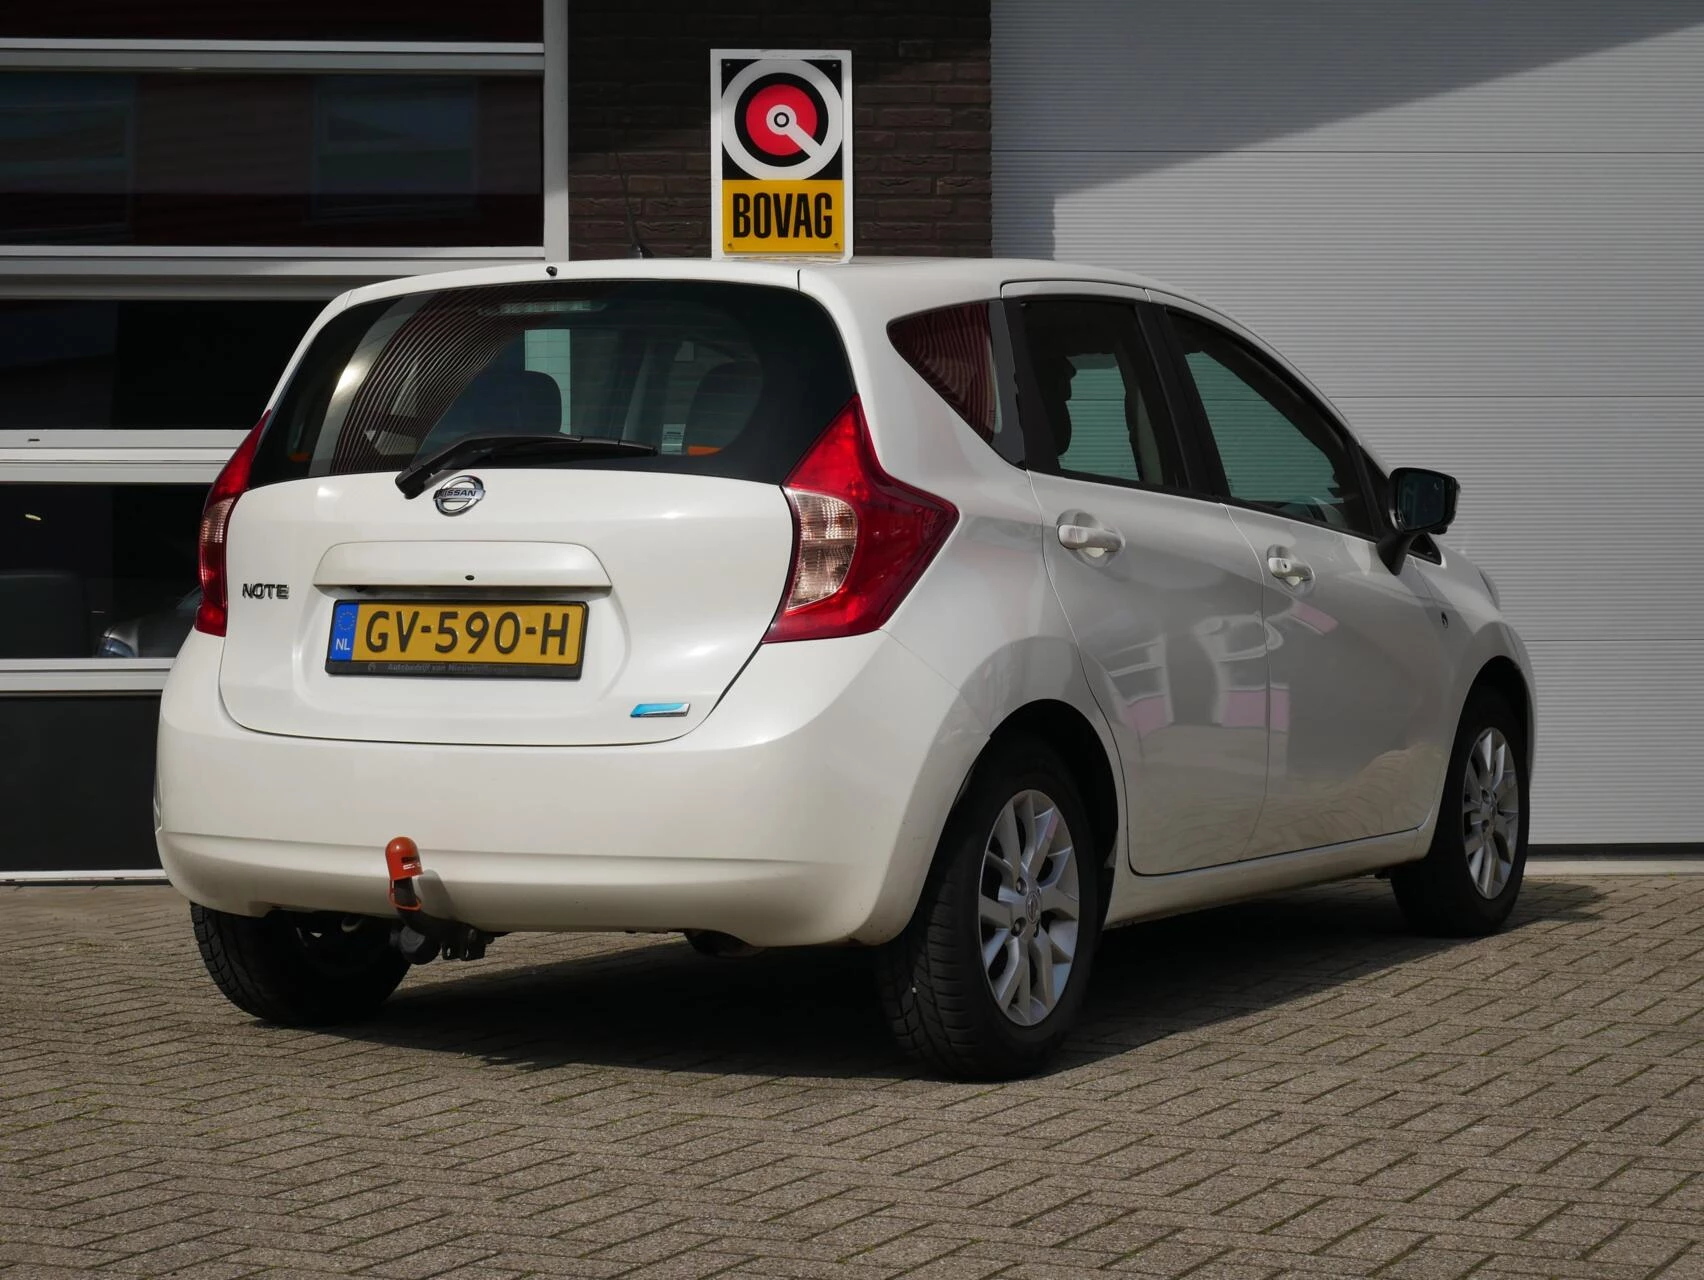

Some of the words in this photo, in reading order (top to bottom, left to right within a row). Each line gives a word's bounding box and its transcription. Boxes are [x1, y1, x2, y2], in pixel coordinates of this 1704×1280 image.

[732, 192, 833, 239] BOVAG
[436, 489, 477, 498] NISSAN
[242, 582, 290, 600] NOTE
[365, 610, 570, 656] GV-590-H
[335, 637, 351, 651] NL
